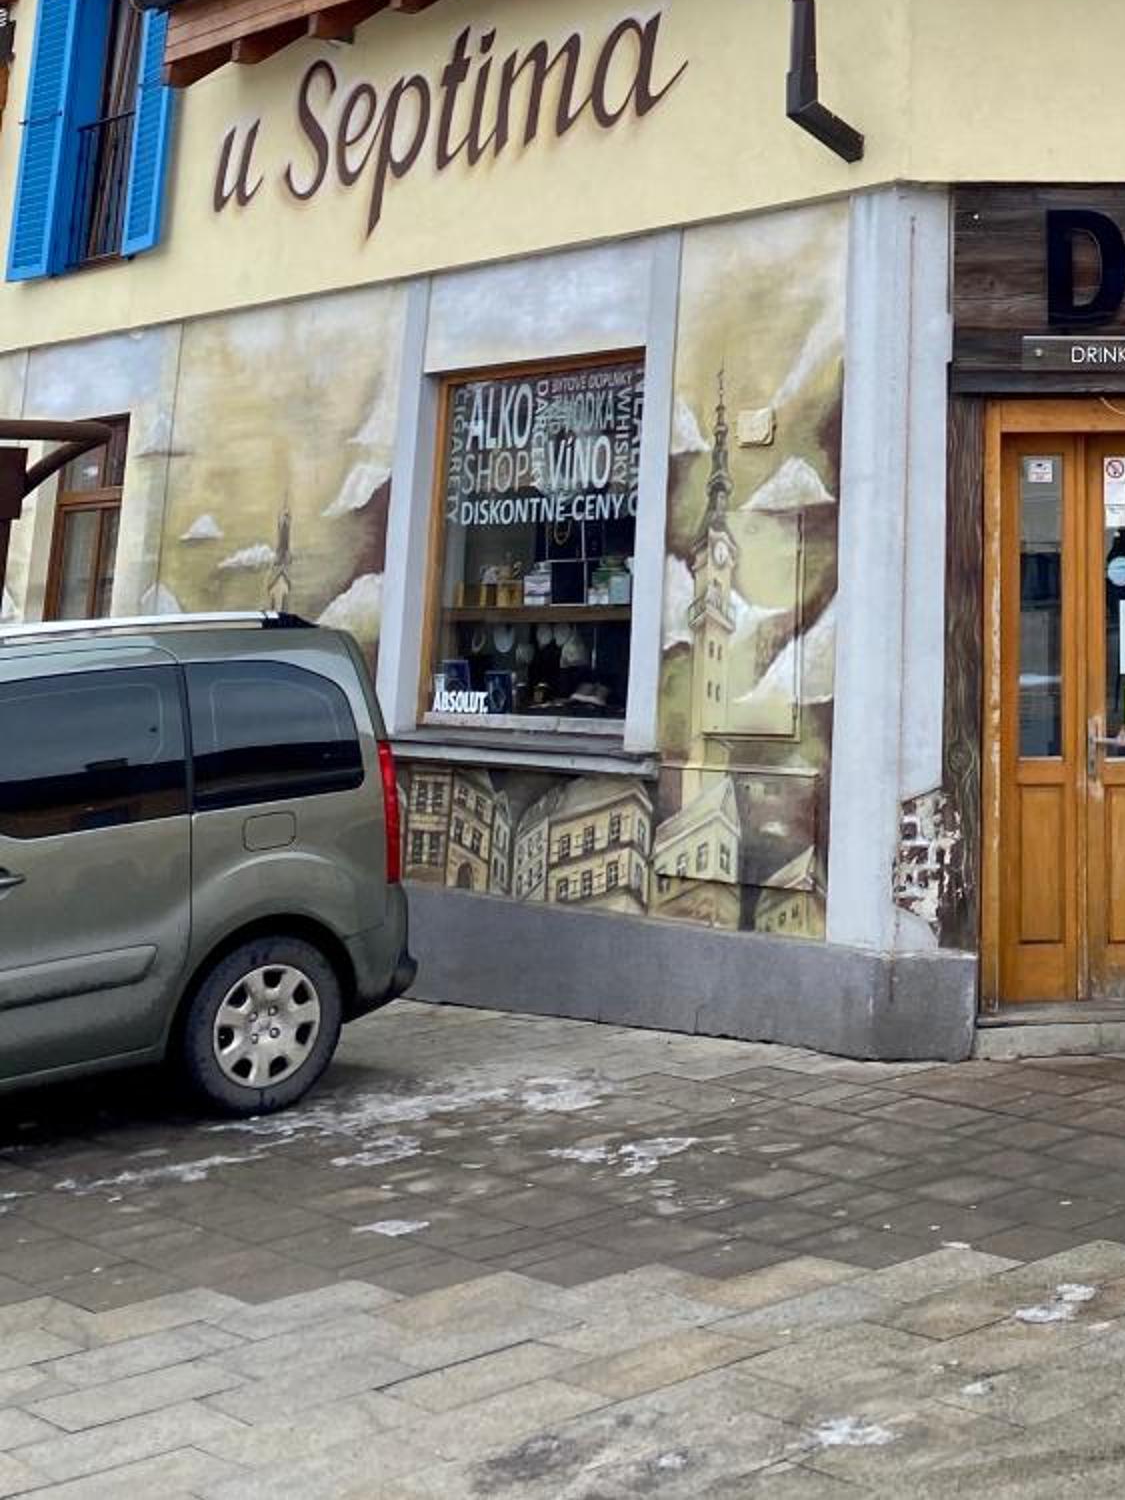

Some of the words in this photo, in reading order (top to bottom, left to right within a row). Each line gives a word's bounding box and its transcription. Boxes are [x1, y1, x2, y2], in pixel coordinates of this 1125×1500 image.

[213, 118, 264, 213] u
[284, 10, 689, 239] Septima
[447, 388, 467, 523] CIGARETY
[466, 383, 533, 450] ALKO
[612, 387, 634, 485] WHISKY
[462, 450, 529, 494] SHOP
[572, 494, 625, 521] CENY
